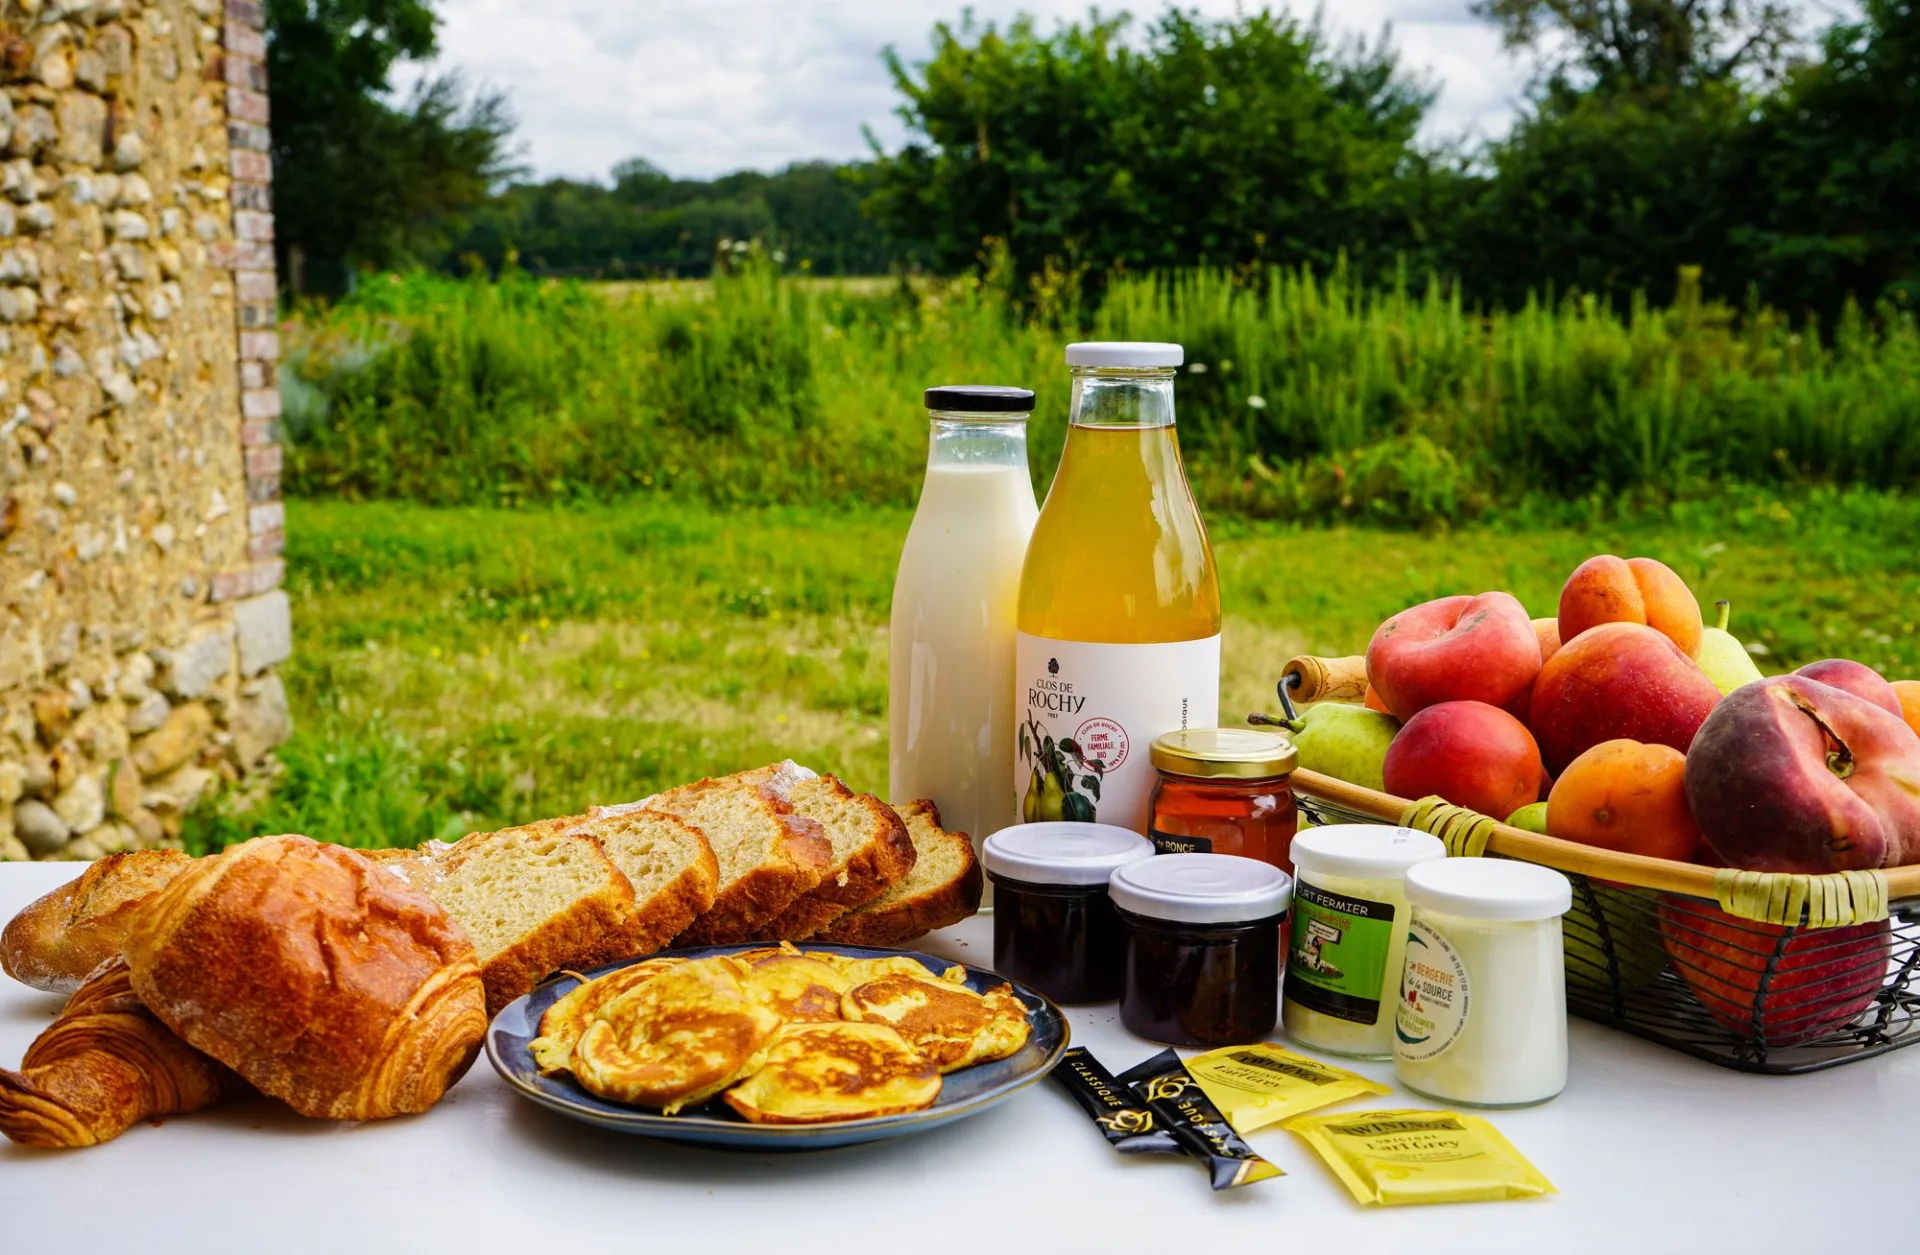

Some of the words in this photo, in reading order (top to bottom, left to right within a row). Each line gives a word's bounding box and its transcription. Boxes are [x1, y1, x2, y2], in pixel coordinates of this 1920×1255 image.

[1037, 679, 1057, 691] CLOS
[1060, 682, 1073, 693] DE
[1029, 688, 1086, 714] ROCHY
[1091, 733, 1108, 741] FERME
[1087, 742, 1114, 750] FAMILIALE
[1165, 841, 1195, 853] RONCE
[1317, 894, 1368, 915] FERMIER
[1416, 962, 1454, 987] BERGERIE
[1422, 981, 1454, 1002] SOURCE
[1070, 1062, 1123, 1107] CLASSIQUE
[1341, 1120, 1452, 1136] TWININGS
[1366, 1142, 1407, 1152] Earl
[1415, 1139, 1460, 1152] Grey
[1376, 1135, 1438, 1144] ORIGINAL
